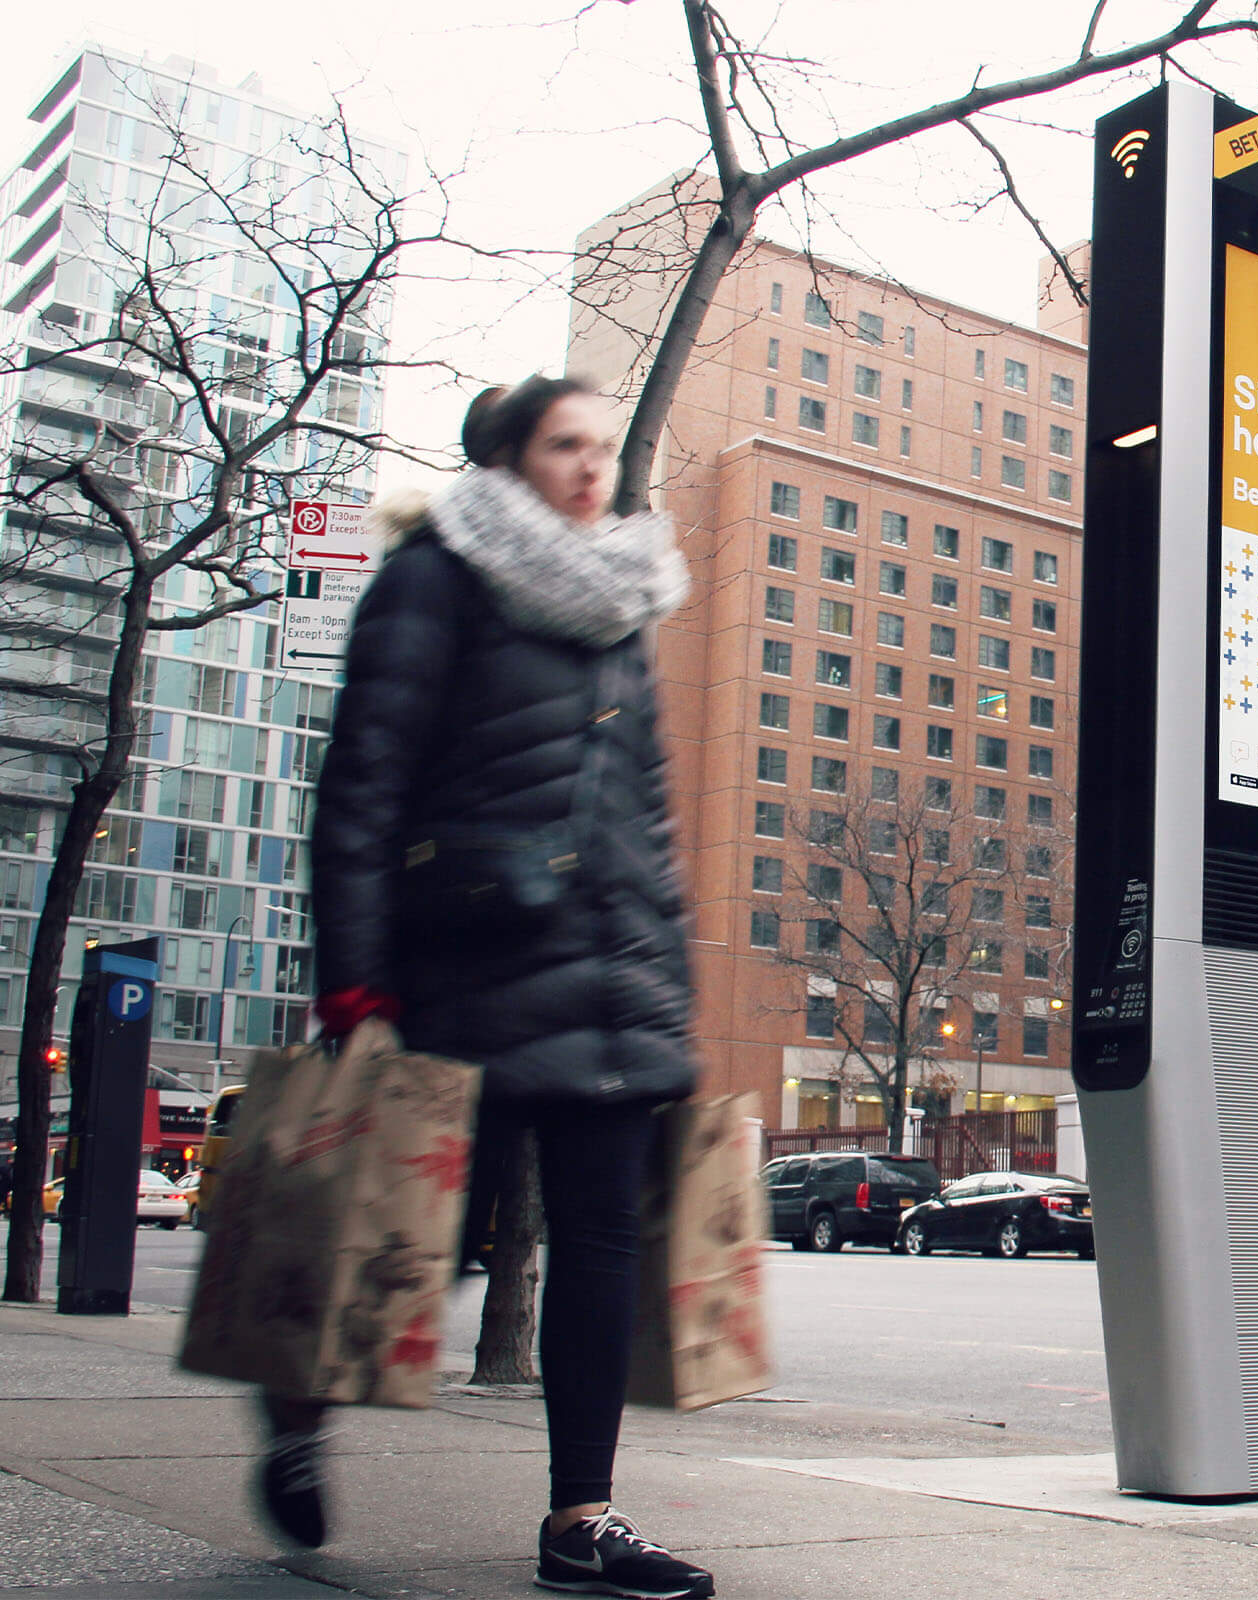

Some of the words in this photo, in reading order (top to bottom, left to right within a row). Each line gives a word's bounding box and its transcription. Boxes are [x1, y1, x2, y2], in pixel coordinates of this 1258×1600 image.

[330, 523, 358, 535] Except
[298, 571, 309, 597] 1
[325, 574, 345, 582] hour
[324, 584, 361, 593] metered
[323, 593, 356, 604] parking
[289, 612, 311, 625] 8am
[320, 615, 348, 627] 10pm
[287, 627, 322, 641] Except
[121, 983, 144, 1016] P
